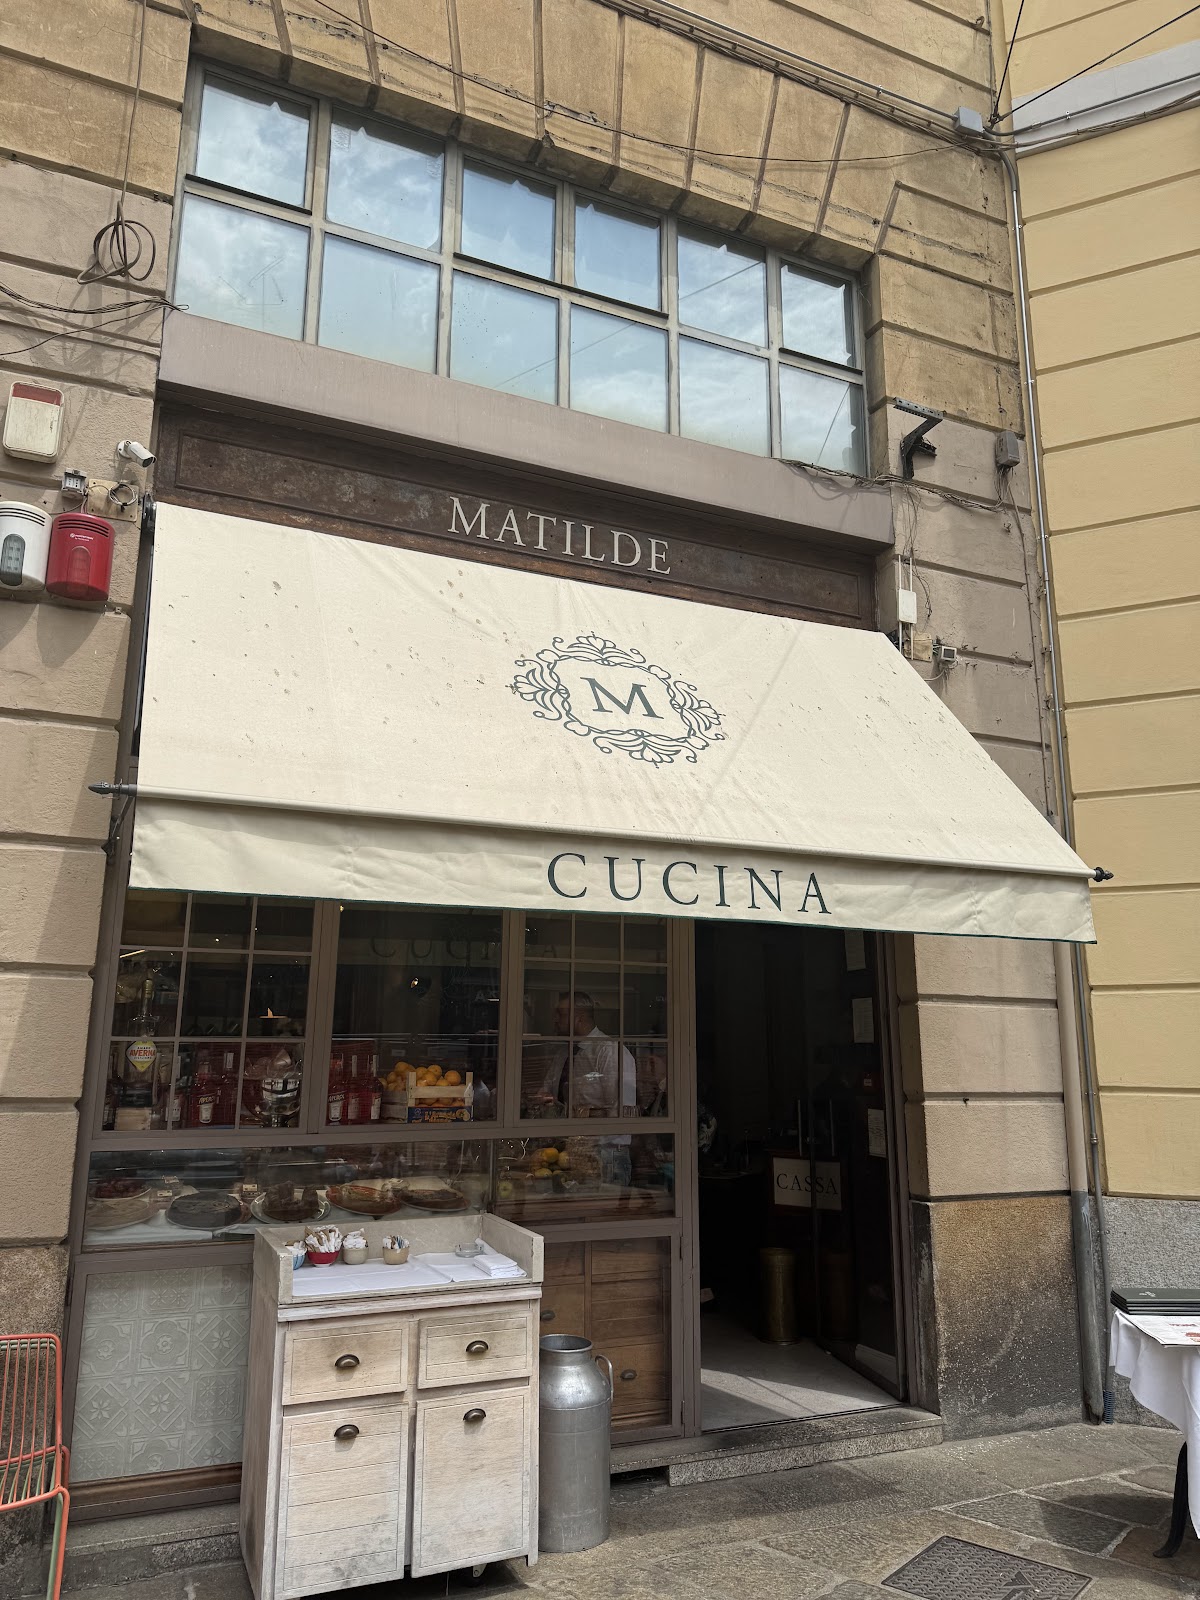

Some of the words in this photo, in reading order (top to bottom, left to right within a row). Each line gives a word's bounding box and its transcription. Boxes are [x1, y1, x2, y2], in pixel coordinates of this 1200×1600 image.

[448, 496, 672, 576] MATILDE
[580, 676, 665, 720] M
[547, 852, 833, 916] CUCINA
[776, 1172, 839, 1195] CASSA
